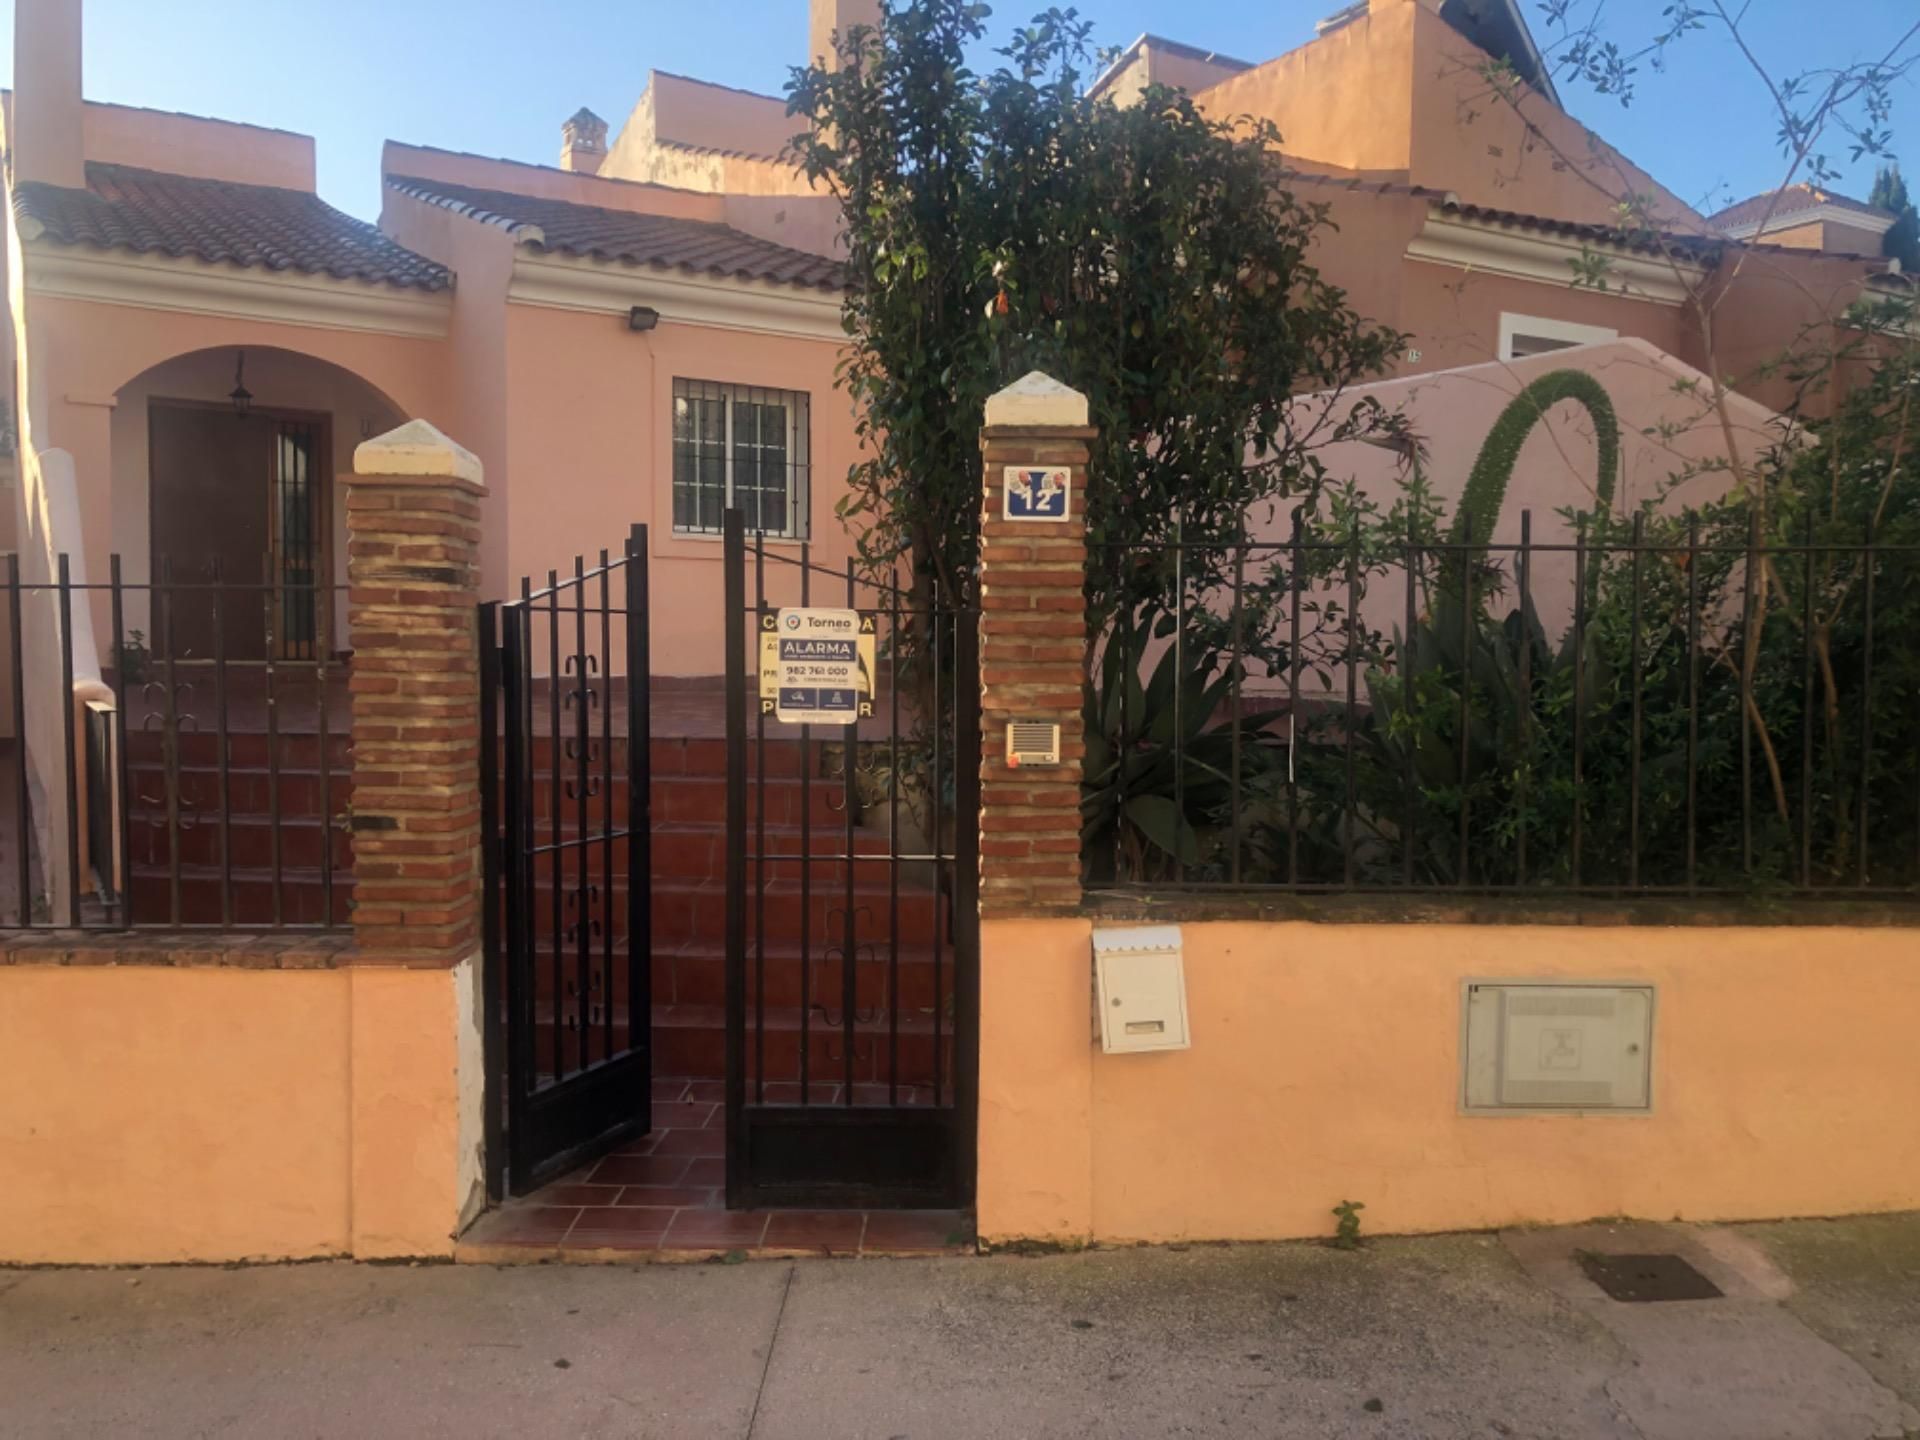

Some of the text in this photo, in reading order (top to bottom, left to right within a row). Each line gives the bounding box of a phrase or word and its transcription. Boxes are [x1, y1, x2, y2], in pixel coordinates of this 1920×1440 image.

[1020, 488, 1052, 511] 12
[807, 616, 852, 629] Torneo
[784, 641, 851, 655] ALARMA
